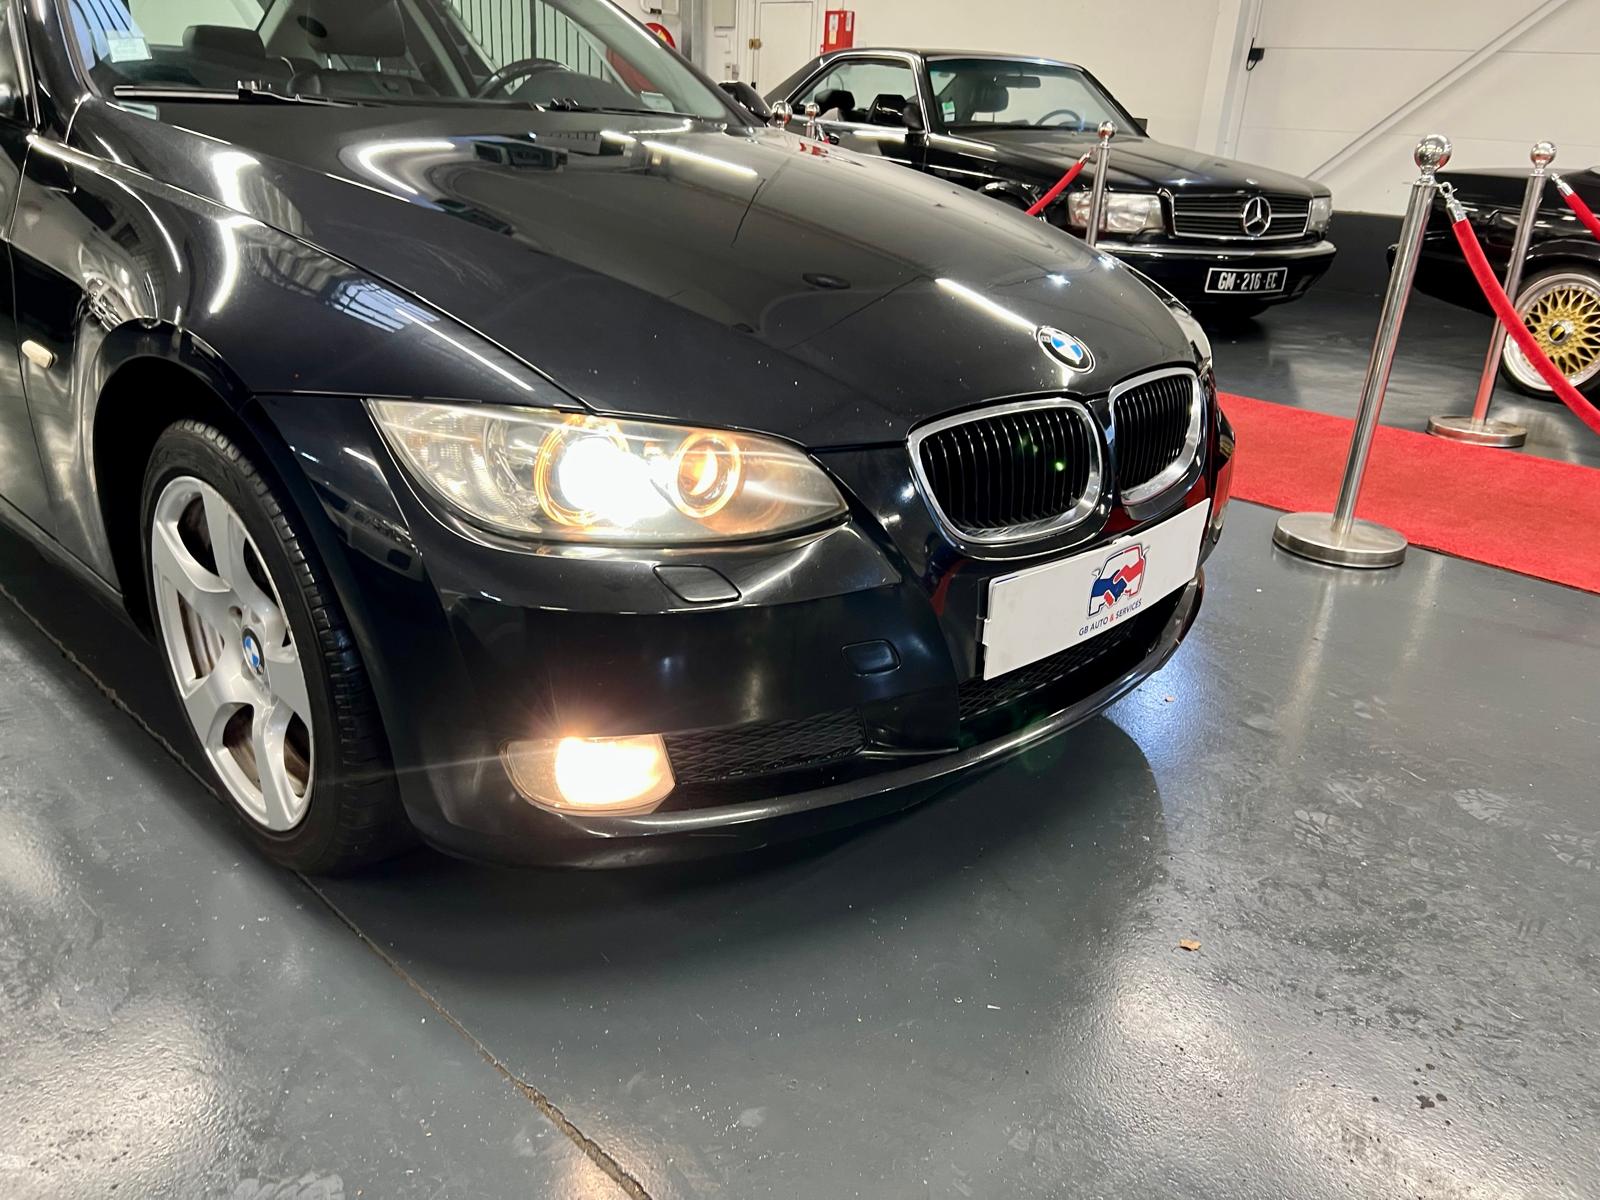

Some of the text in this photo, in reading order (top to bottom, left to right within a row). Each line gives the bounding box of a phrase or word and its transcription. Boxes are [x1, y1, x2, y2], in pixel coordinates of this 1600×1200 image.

[1079, 598, 1142, 636] GB AUTO & SERVICES
